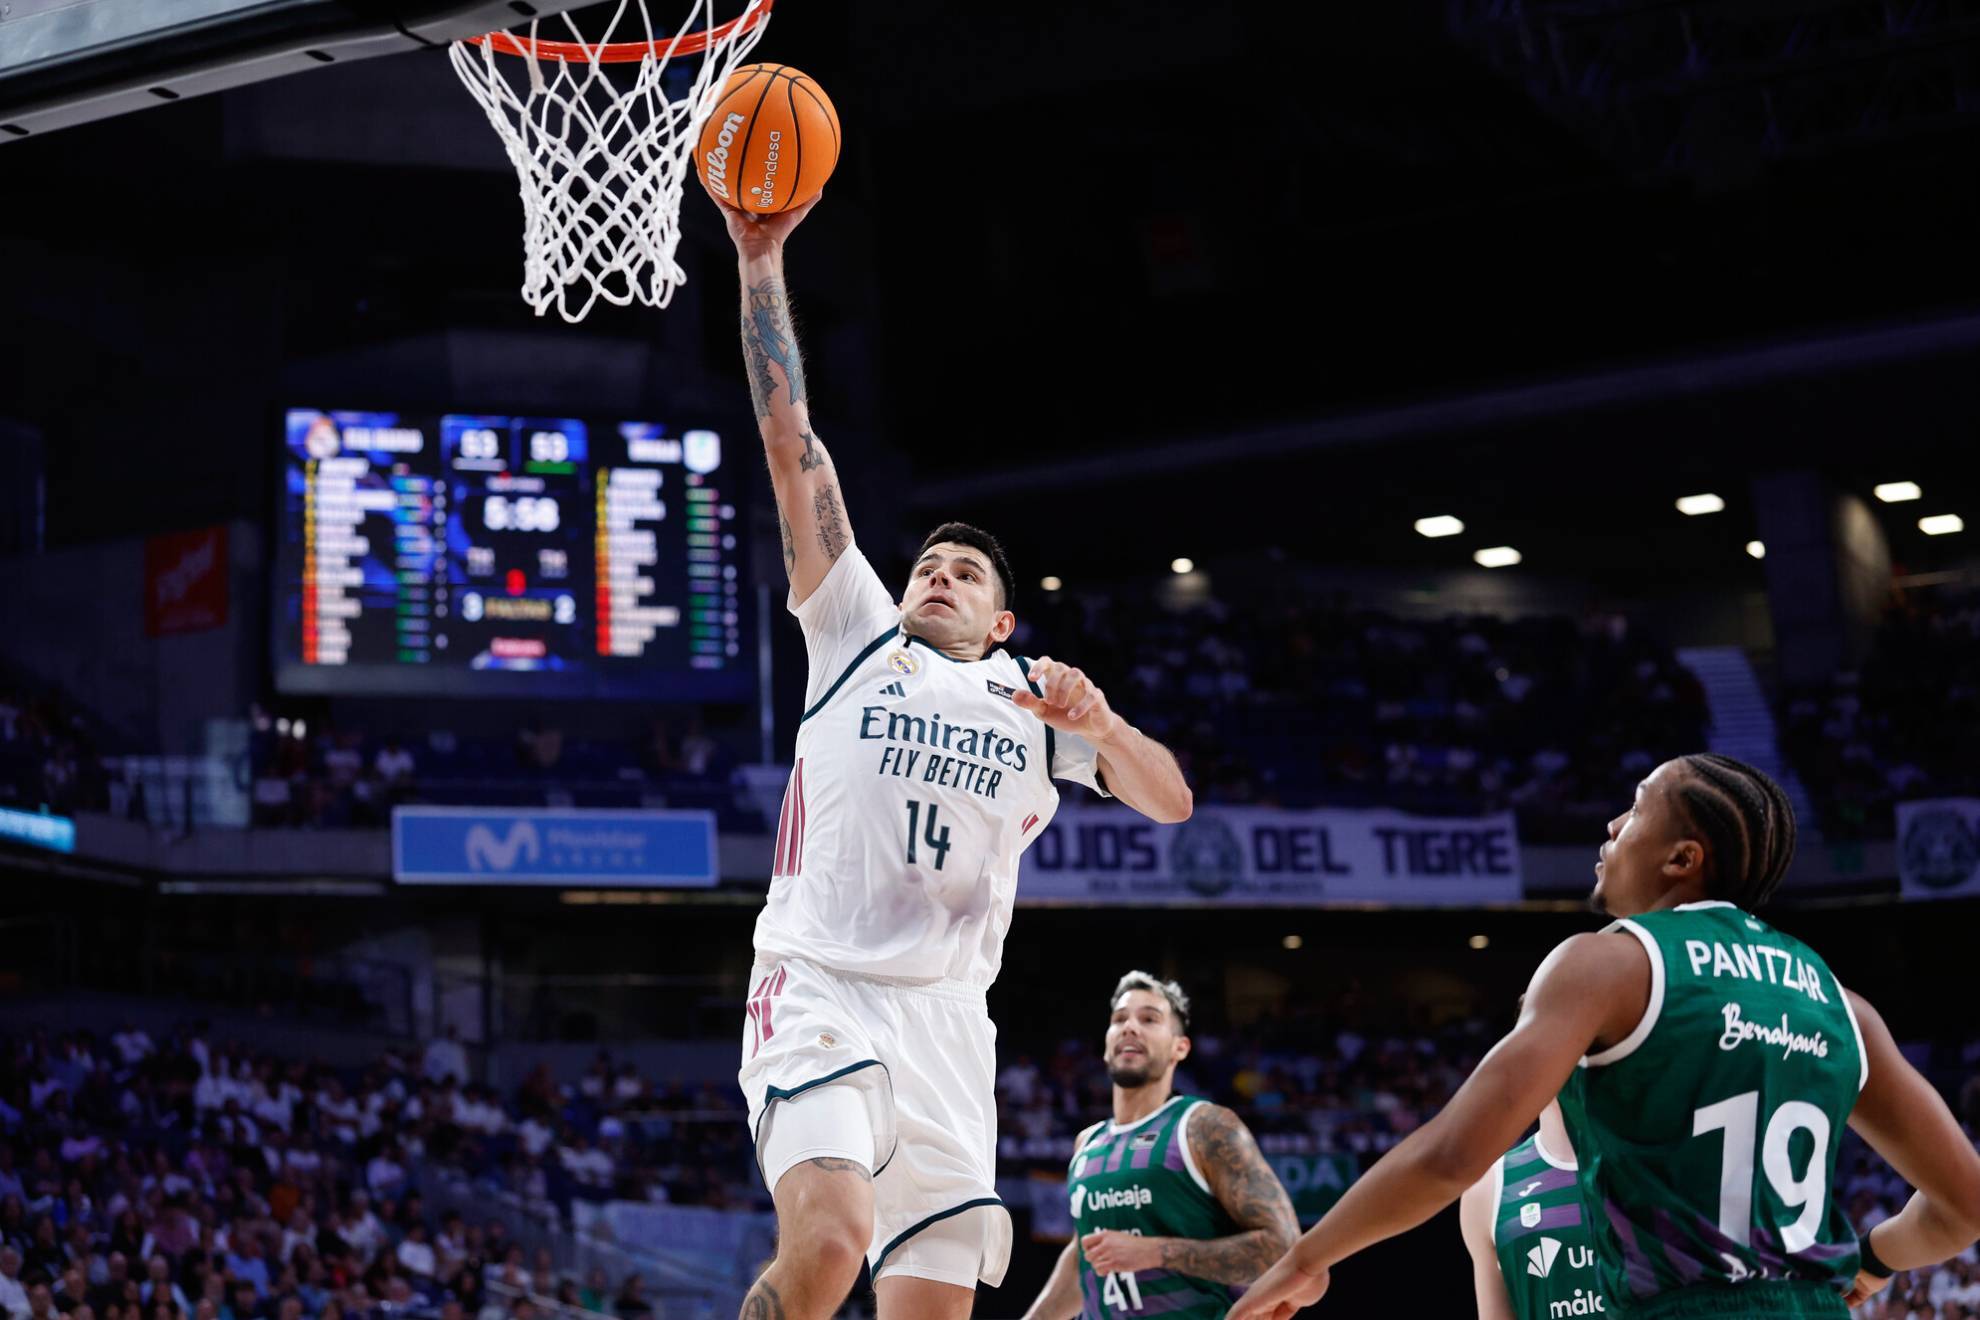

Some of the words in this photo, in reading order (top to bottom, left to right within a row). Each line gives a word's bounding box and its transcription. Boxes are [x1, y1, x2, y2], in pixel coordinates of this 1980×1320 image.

[707, 112, 745, 199] Wilson
[859, 705, 1028, 772] Emirates
[878, 747, 920, 778] FLY
[923, 753, 1003, 799] BETTER
[906, 799, 951, 871] 14
[1035, 822, 1159, 872] OJOS
[1253, 824, 1352, 875] DEL
[1373, 827, 1515, 877] TIGRE
[1685, 939, 1829, 1004] PANTZAR
[1087, 1184, 1153, 1210] Unicaja
[1692, 1090, 1831, 1255] 19
[1103, 1271, 1144, 1311] 41
